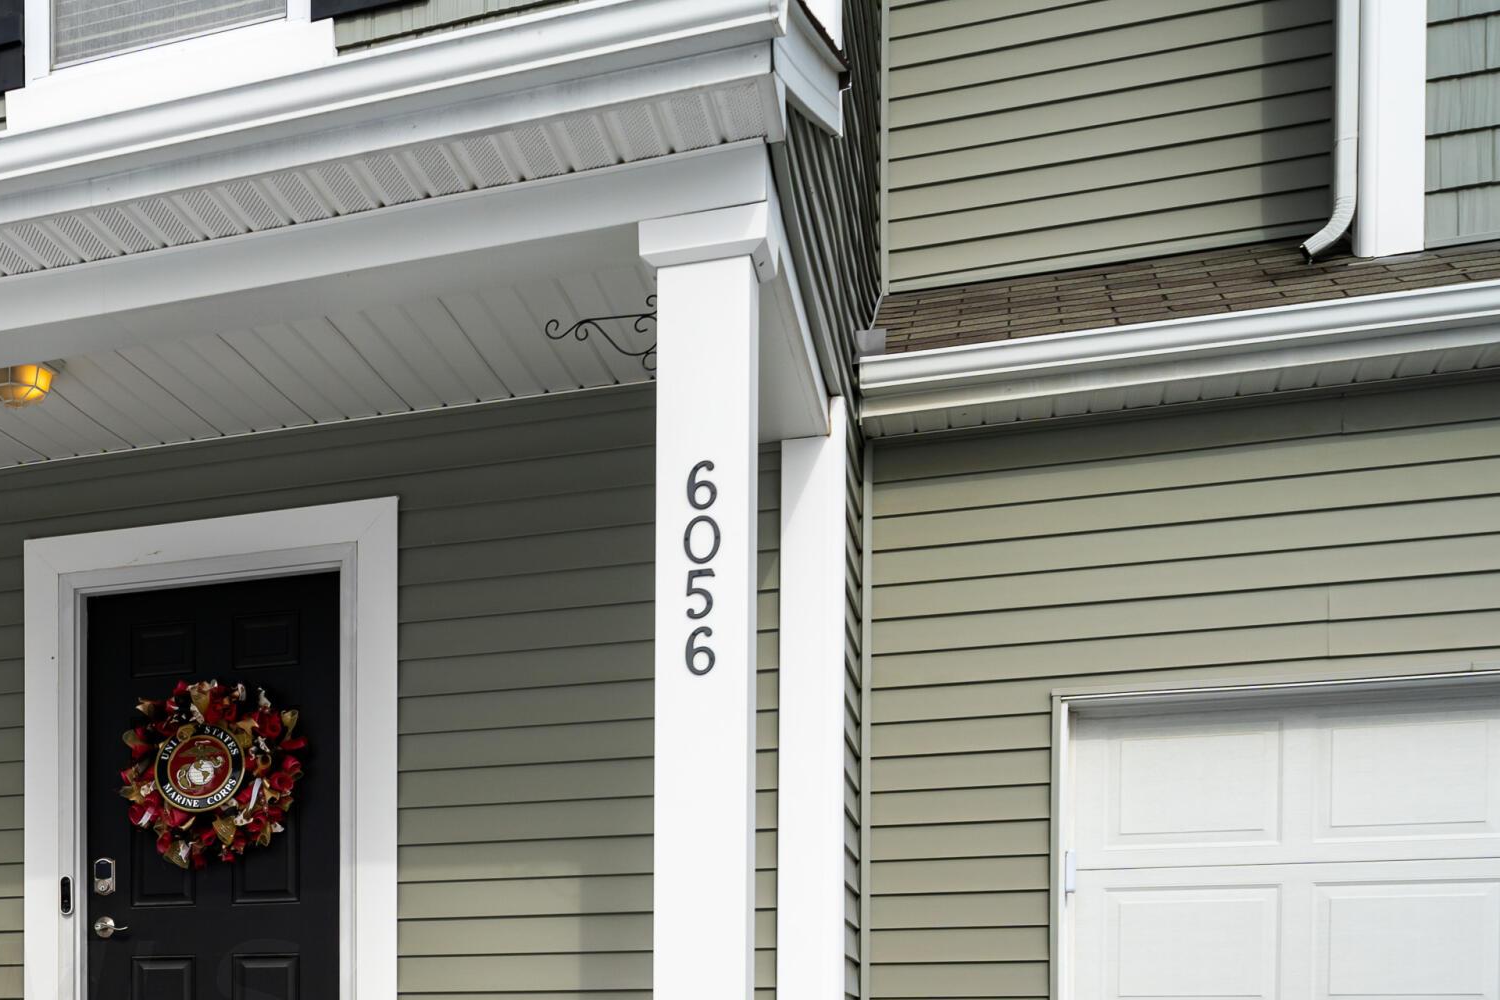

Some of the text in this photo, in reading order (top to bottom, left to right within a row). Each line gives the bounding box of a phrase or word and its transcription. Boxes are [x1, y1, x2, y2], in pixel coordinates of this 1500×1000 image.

[683, 460, 721, 676] 6056
[204, 725, 239, 755] STATES
[163, 778, 237, 808] MARINE CORPS
